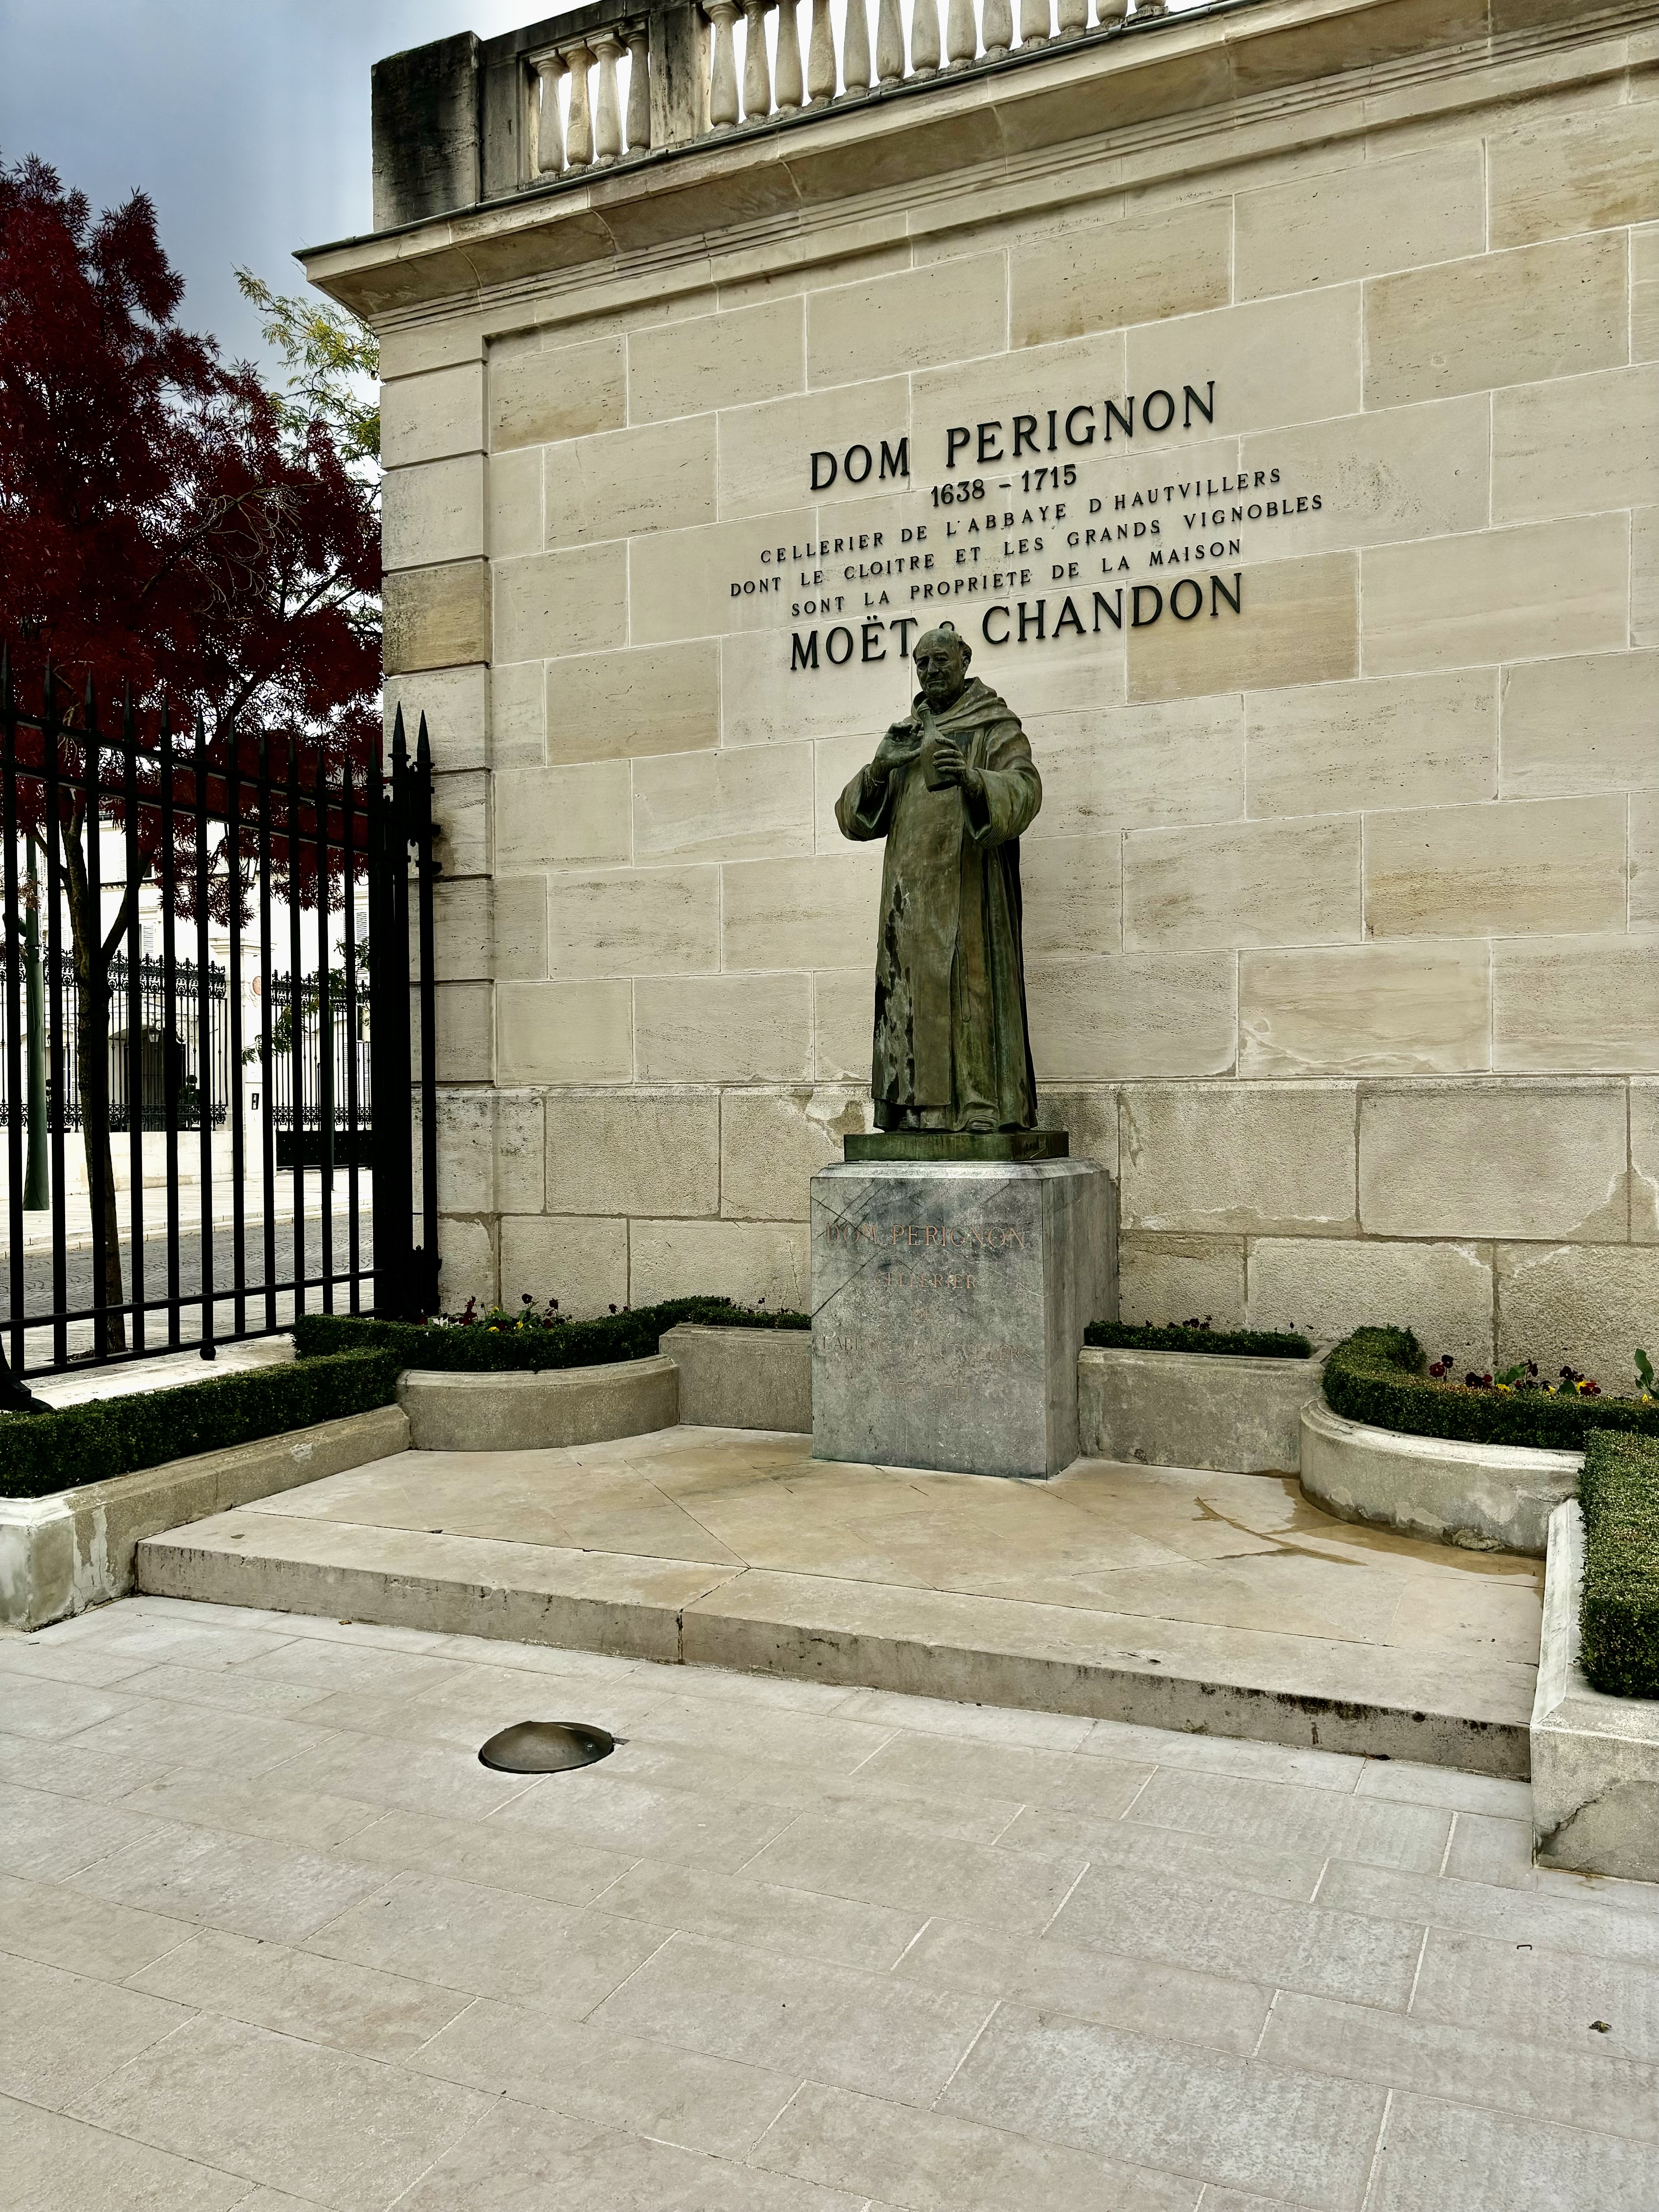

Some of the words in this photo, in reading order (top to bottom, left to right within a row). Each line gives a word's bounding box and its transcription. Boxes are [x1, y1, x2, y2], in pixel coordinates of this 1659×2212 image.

[810, 437, 910, 491] DOM
[946, 381, 1215, 469] PERIGNON
[931, 479, 985, 508] 1638
[1022, 464, 1077, 493] 1715
[731, 577, 781, 596] DONT
[801, 570, 823, 587] LE
[844, 553, 934, 580] CLOITRE
[955, 546, 981, 564] ET
[1004, 537, 1043, 556] LES
[1067, 520, 1160, 547] GRANDS
[1183, 495, 1322, 529] VIGNOBLES
[761, 532, 883, 563] CELLERIER
[901, 526, 927, 542] DE
[792, 596, 844, 616] SONT
[864, 590, 890, 606] LA
[910, 569, 1030, 600] PROPRIETE
[1052, 562, 1079, 579] DE
[1102, 556, 1130, 573] LA
[1149, 539, 1240, 566] MAISON
[790, 615, 918, 672] MOËT
[982, 572, 1242, 646] CHANDON
[825, 1223, 880, 1244] DOM
[892, 1224, 1025, 1250] PERIGNON
[873, 1271, 976, 1289] CELLERIER
